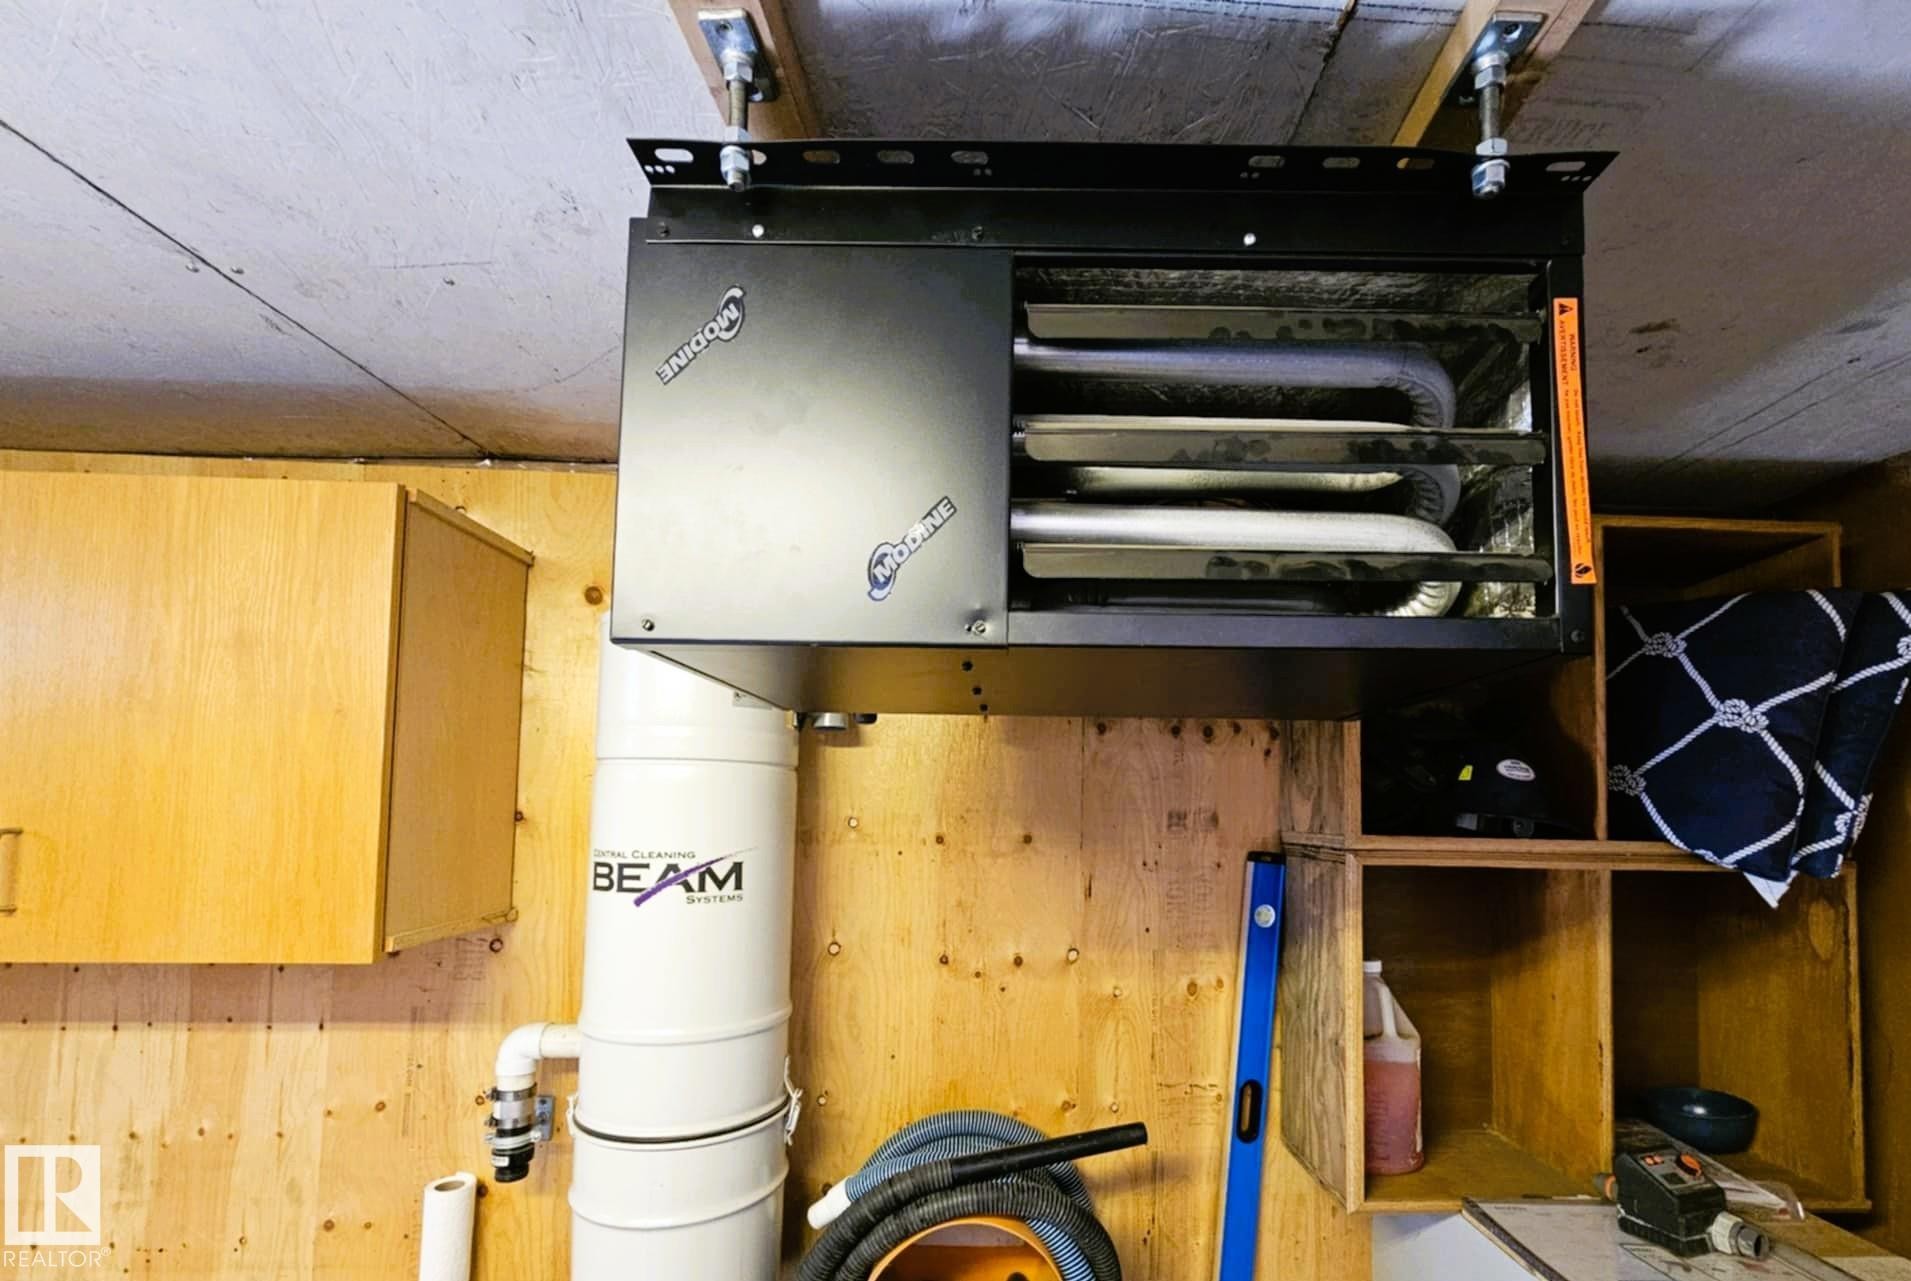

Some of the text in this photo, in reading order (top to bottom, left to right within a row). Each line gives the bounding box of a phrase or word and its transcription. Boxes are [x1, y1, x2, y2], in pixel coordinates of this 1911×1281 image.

[657, 296, 743, 385] MODINE
[1568, 333, 1577, 371] WARNING
[870, 497, 957, 591] MODINE
[631, 849, 696, 859] CLEANING
[593, 861, 743, 893] BEAM
[686, 894, 744, 905] SYSTEMS
